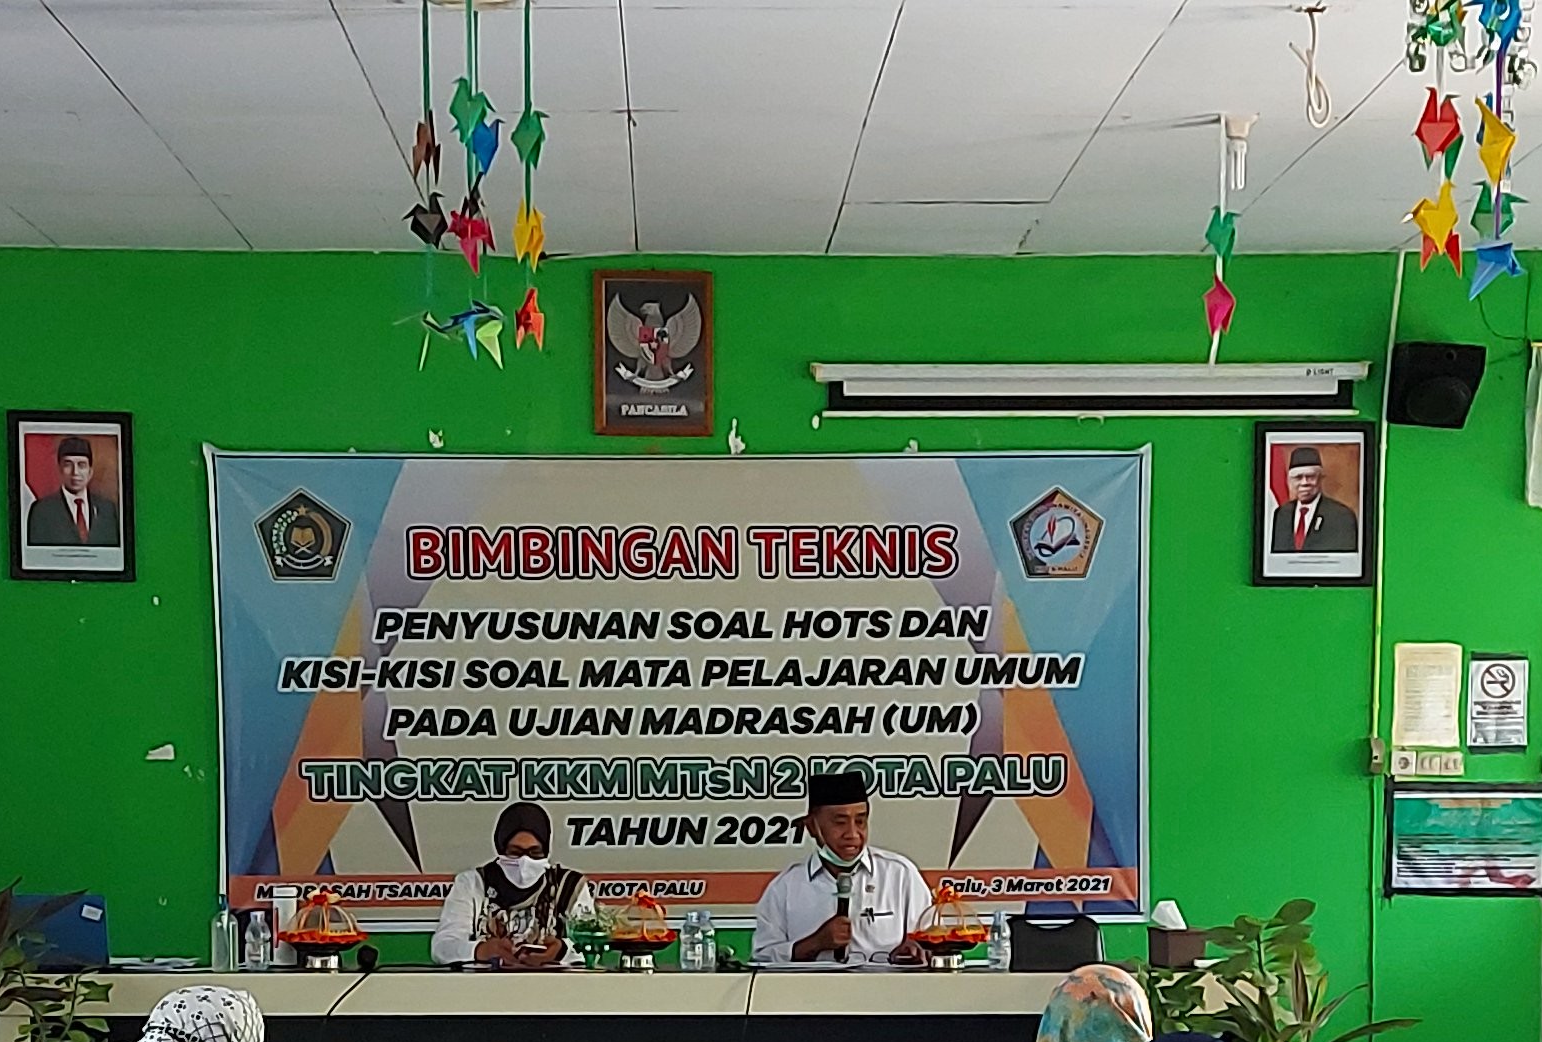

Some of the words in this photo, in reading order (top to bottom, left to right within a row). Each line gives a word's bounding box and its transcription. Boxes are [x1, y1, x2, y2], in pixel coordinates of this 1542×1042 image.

[621, 404, 688, 416] PANCASILA
[406, 524, 741, 580] BIMBINGAN
[748, 524, 959, 580] TEKNIS
[375, 610, 660, 640] PENYUSUNAN
[667, 610, 773, 640] SOAL
[782, 609, 891, 639] HOTS
[899, 608, 987, 638] DAN
[281, 659, 456, 689] KISI-KISI
[462, 659, 570, 689] SOAL
[578, 658, 692, 688] MATA
[701, 658, 946, 687] PELAJARAN
[958, 656, 1081, 686] UMUM
[387, 708, 498, 738] PADA
[508, 707, 634, 737] UJIAN
[640, 706, 877, 736] MADRASAH
[882, 703, 979, 737] (UM)
[299, 757, 519, 802] TINGKAT
[519, 757, 632, 801] KKM
[636, 755, 770, 800] MTsN
[770, 755, 808, 799] 2
[943, 753, 1068, 797] PALU
[566, 817, 707, 846] TAHUN
[714, 816, 806, 846] 2021
[599, 882, 649, 897] KOTA
[653, 882, 705, 896] PALU
[992, 879, 1004, 893] 3
[1066, 877, 1110, 892] 2021
